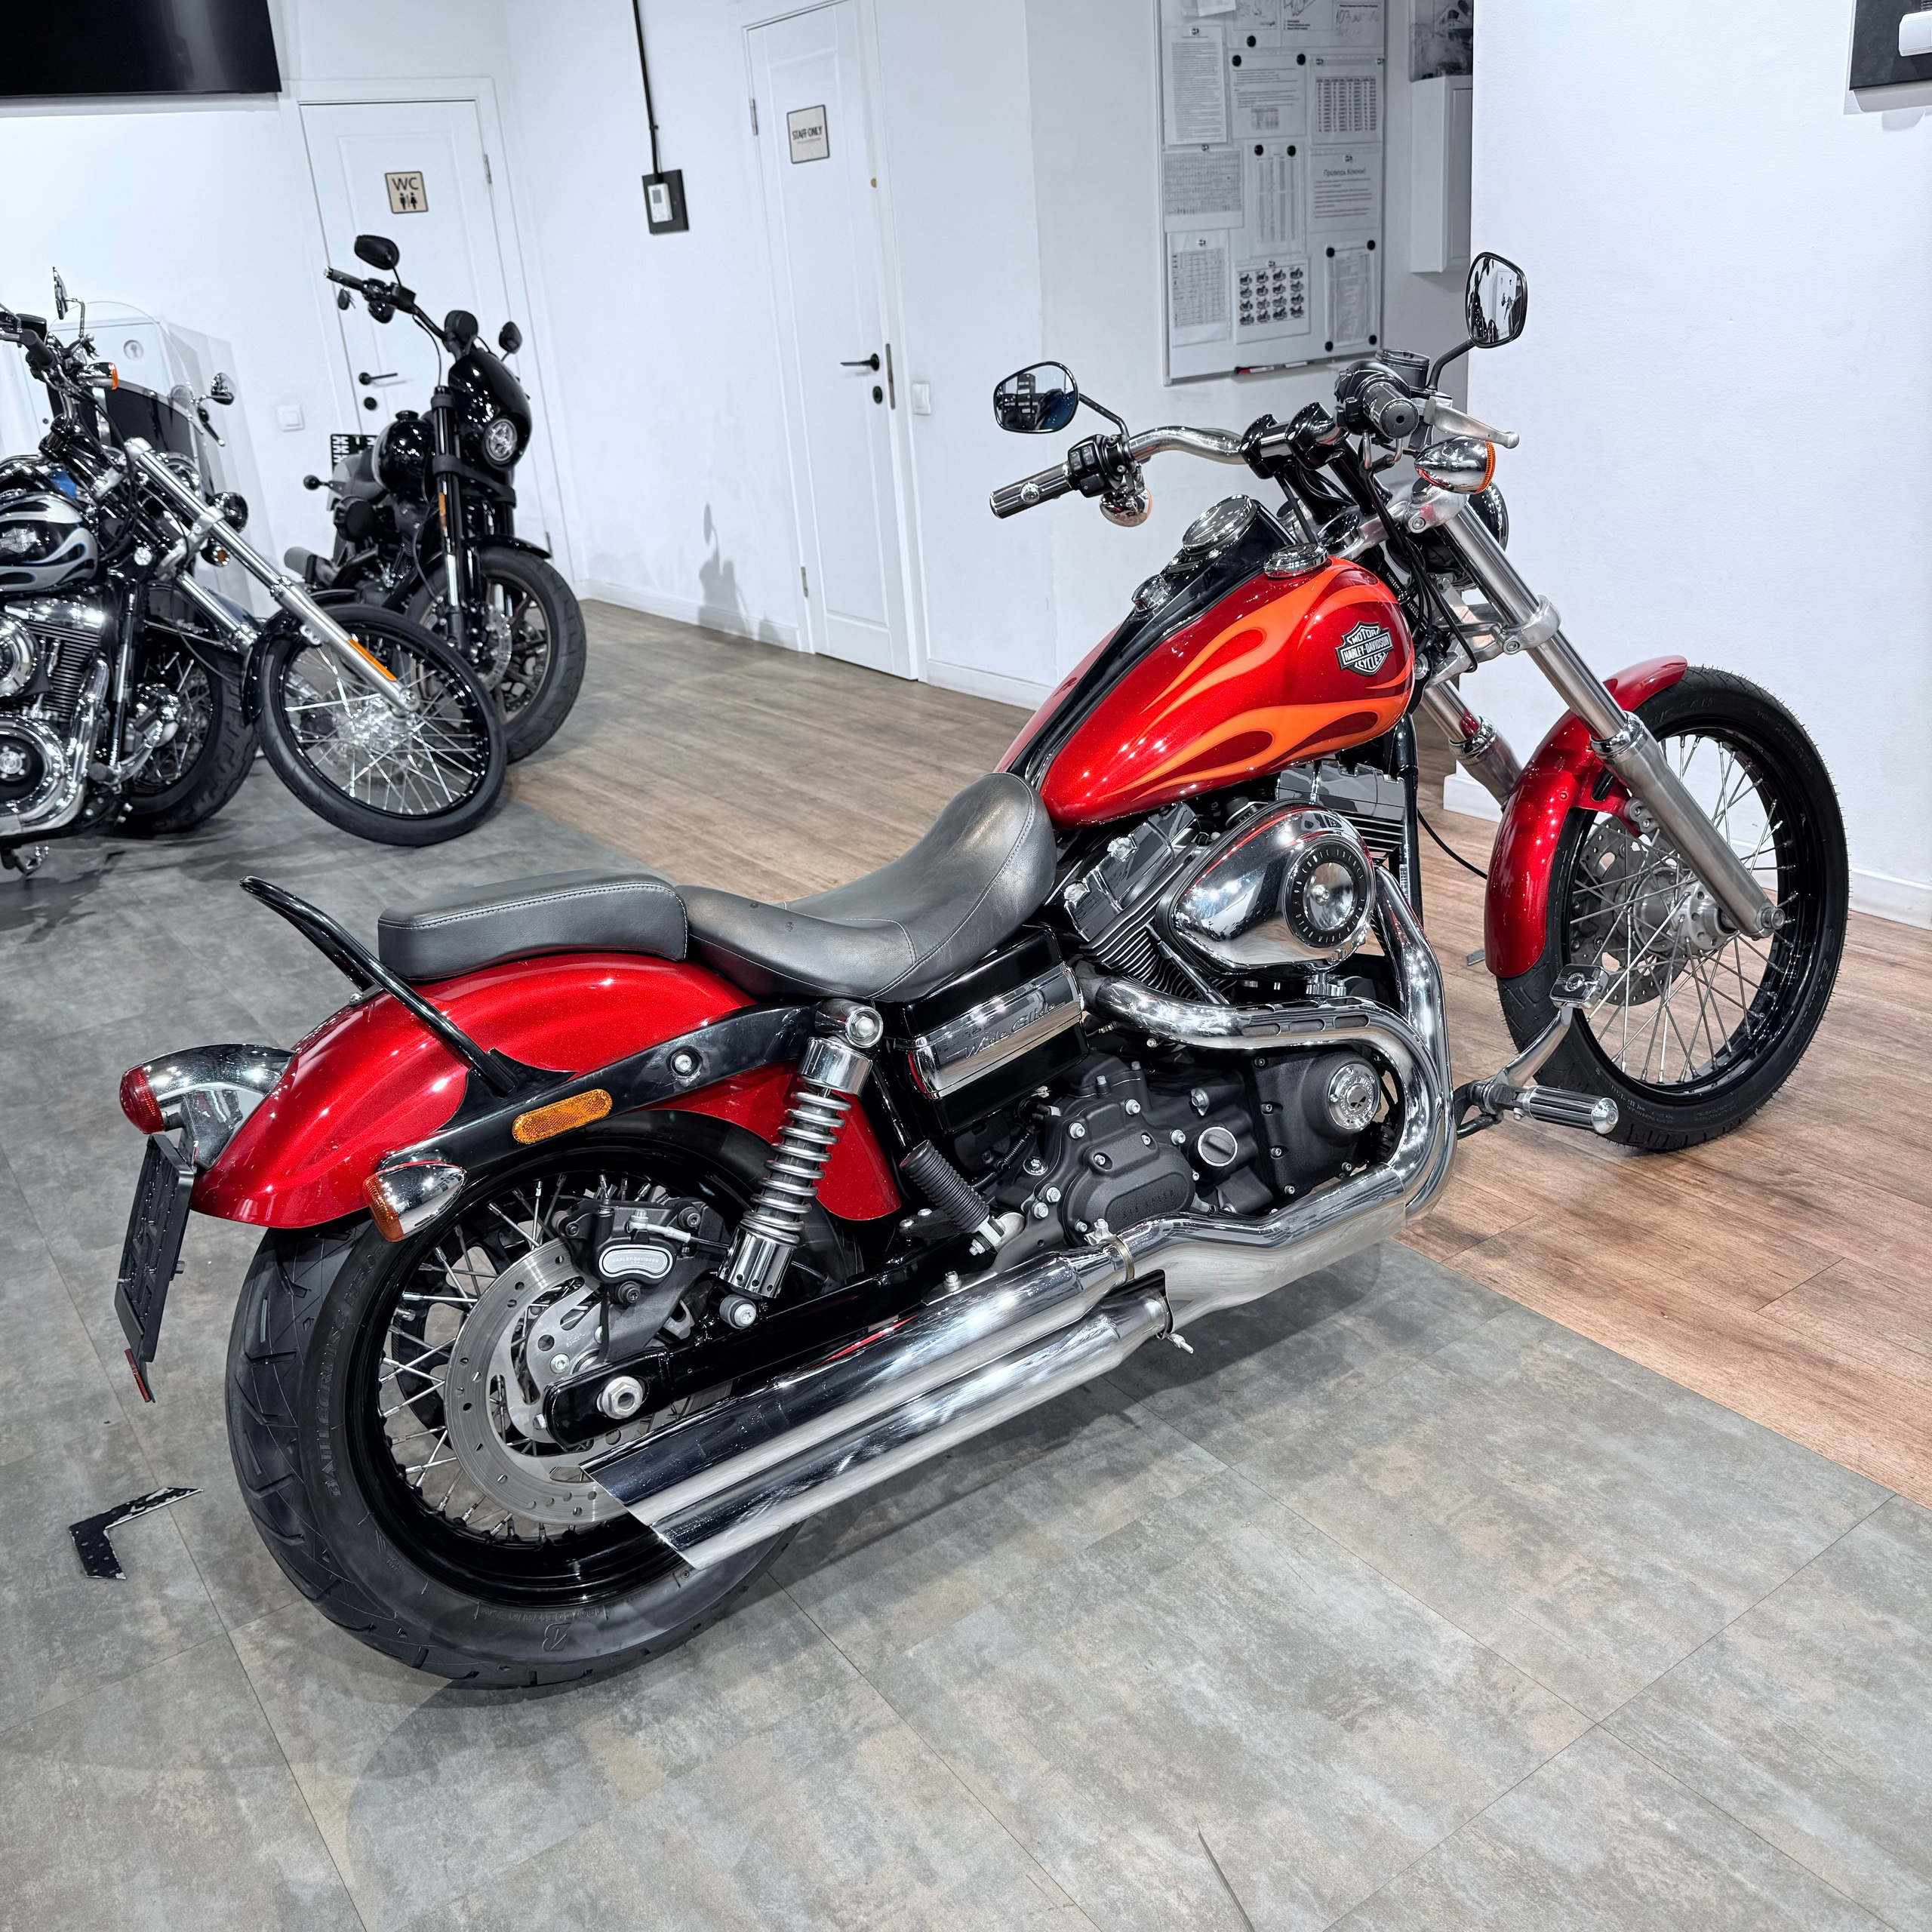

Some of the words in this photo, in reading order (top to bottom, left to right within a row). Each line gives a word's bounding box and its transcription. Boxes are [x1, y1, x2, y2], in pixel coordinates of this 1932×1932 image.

[792, 128, 807, 140] STAFF
[808, 125, 823, 137] ONLY
[392, 177, 419, 191] WC
[1352, 628, 1378, 644] MOTOR
[1344, 636, 1389, 661] HARLEY-DAVIDSON
[1358, 654, 1382, 670] CYCLES
